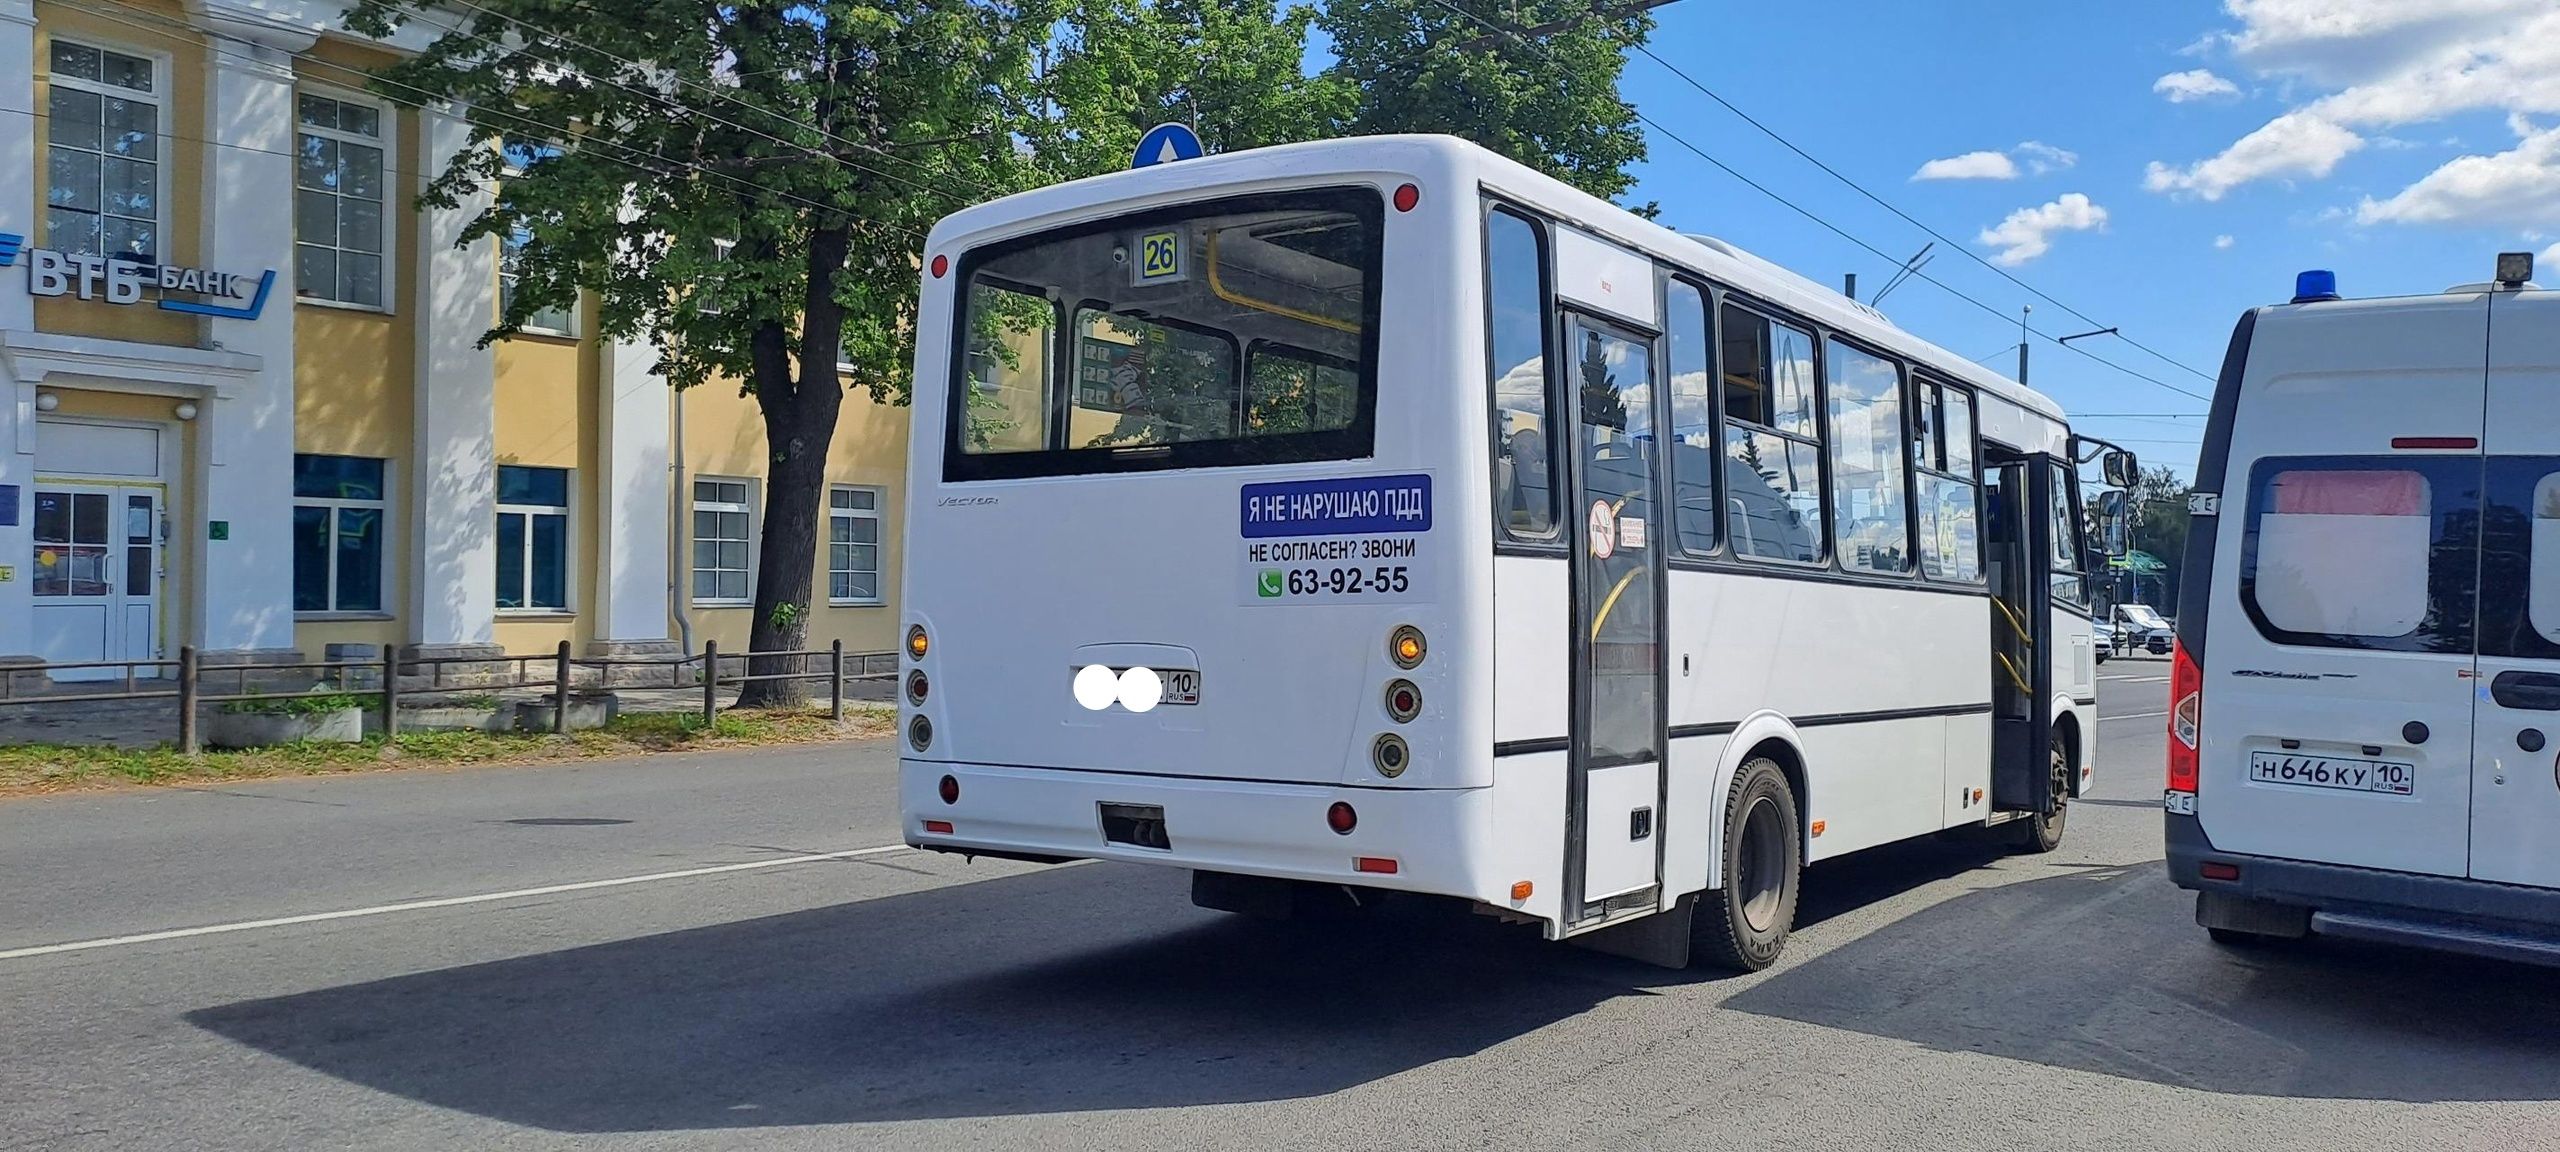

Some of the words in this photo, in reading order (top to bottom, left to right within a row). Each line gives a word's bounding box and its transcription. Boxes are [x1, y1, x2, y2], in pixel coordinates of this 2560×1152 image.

[1146, 237, 1174, 272] 26
[29, 248, 142, 305] ВТБ
[158, 264, 244, 299] БАНК
[1248, 496, 1260, 522] Я
[1264, 495, 1286, 522] НЕ
[1291, 490, 1379, 521] НАРУШАЮ
[1384, 488, 1423, 521] ПДД
[1249, 543, 1268, 562] НЕ
[1272, 541, 1357, 562] СОГЛАСЕН?
[1362, 538, 1416, 559] ЗВОНИ
[1288, 567, 1409, 595] 63-92-55
[1172, 673, 1192, 693] 10
[1168, 692, 1184, 701] RUS
[2377, 765, 2403, 783] 10
[2374, 782, 2394, 791] RUS
